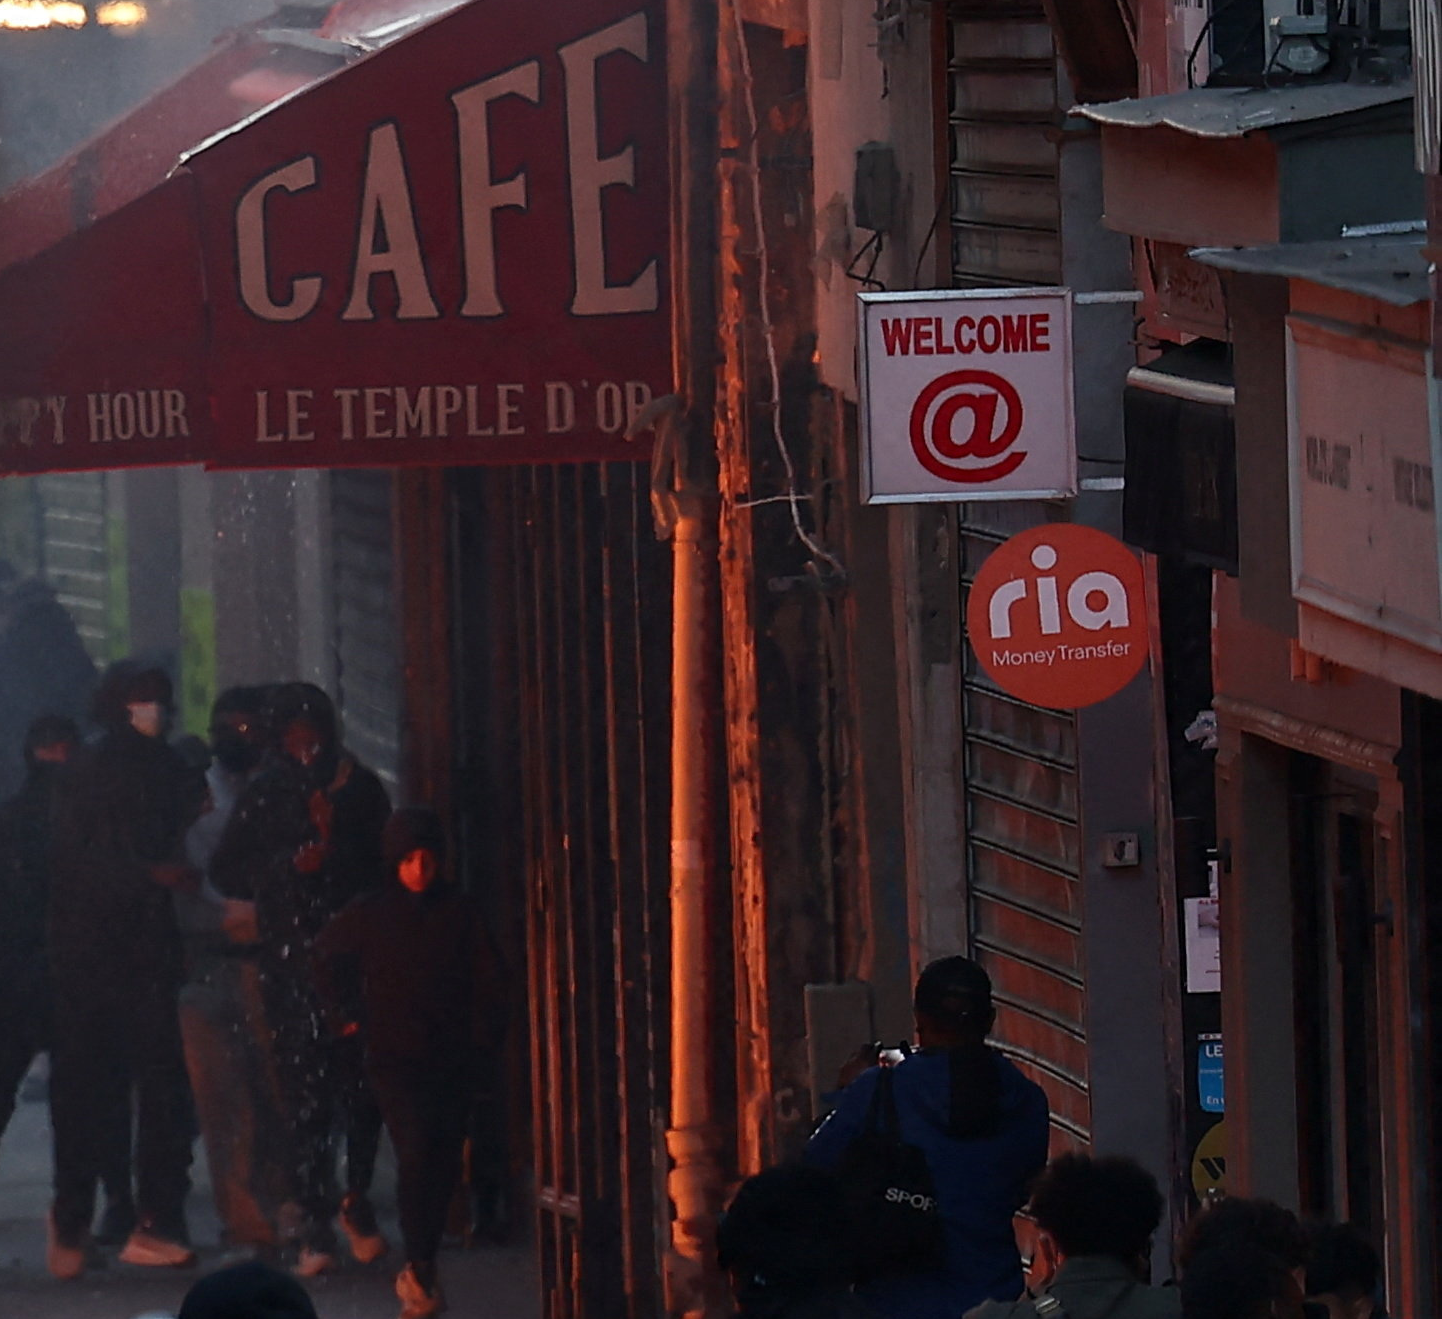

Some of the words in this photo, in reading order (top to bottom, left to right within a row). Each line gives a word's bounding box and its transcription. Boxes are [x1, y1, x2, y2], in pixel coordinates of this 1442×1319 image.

[234, 10, 661, 323] CAFE
[879, 312, 1051, 358] WELCOME
[87, 389, 191, 443] HOUR
[255, 389, 316, 444] LE
[333, 384, 526, 441] TEMPLE
[544, 380, 654, 435] D'OR
[908, 368, 1029, 484] @
[987, 543, 1131, 641] ria
[991, 646, 1056, 670] Money
[1057, 639, 1132, 664] Transfer
[883, 1186, 936, 1212] SPOR
